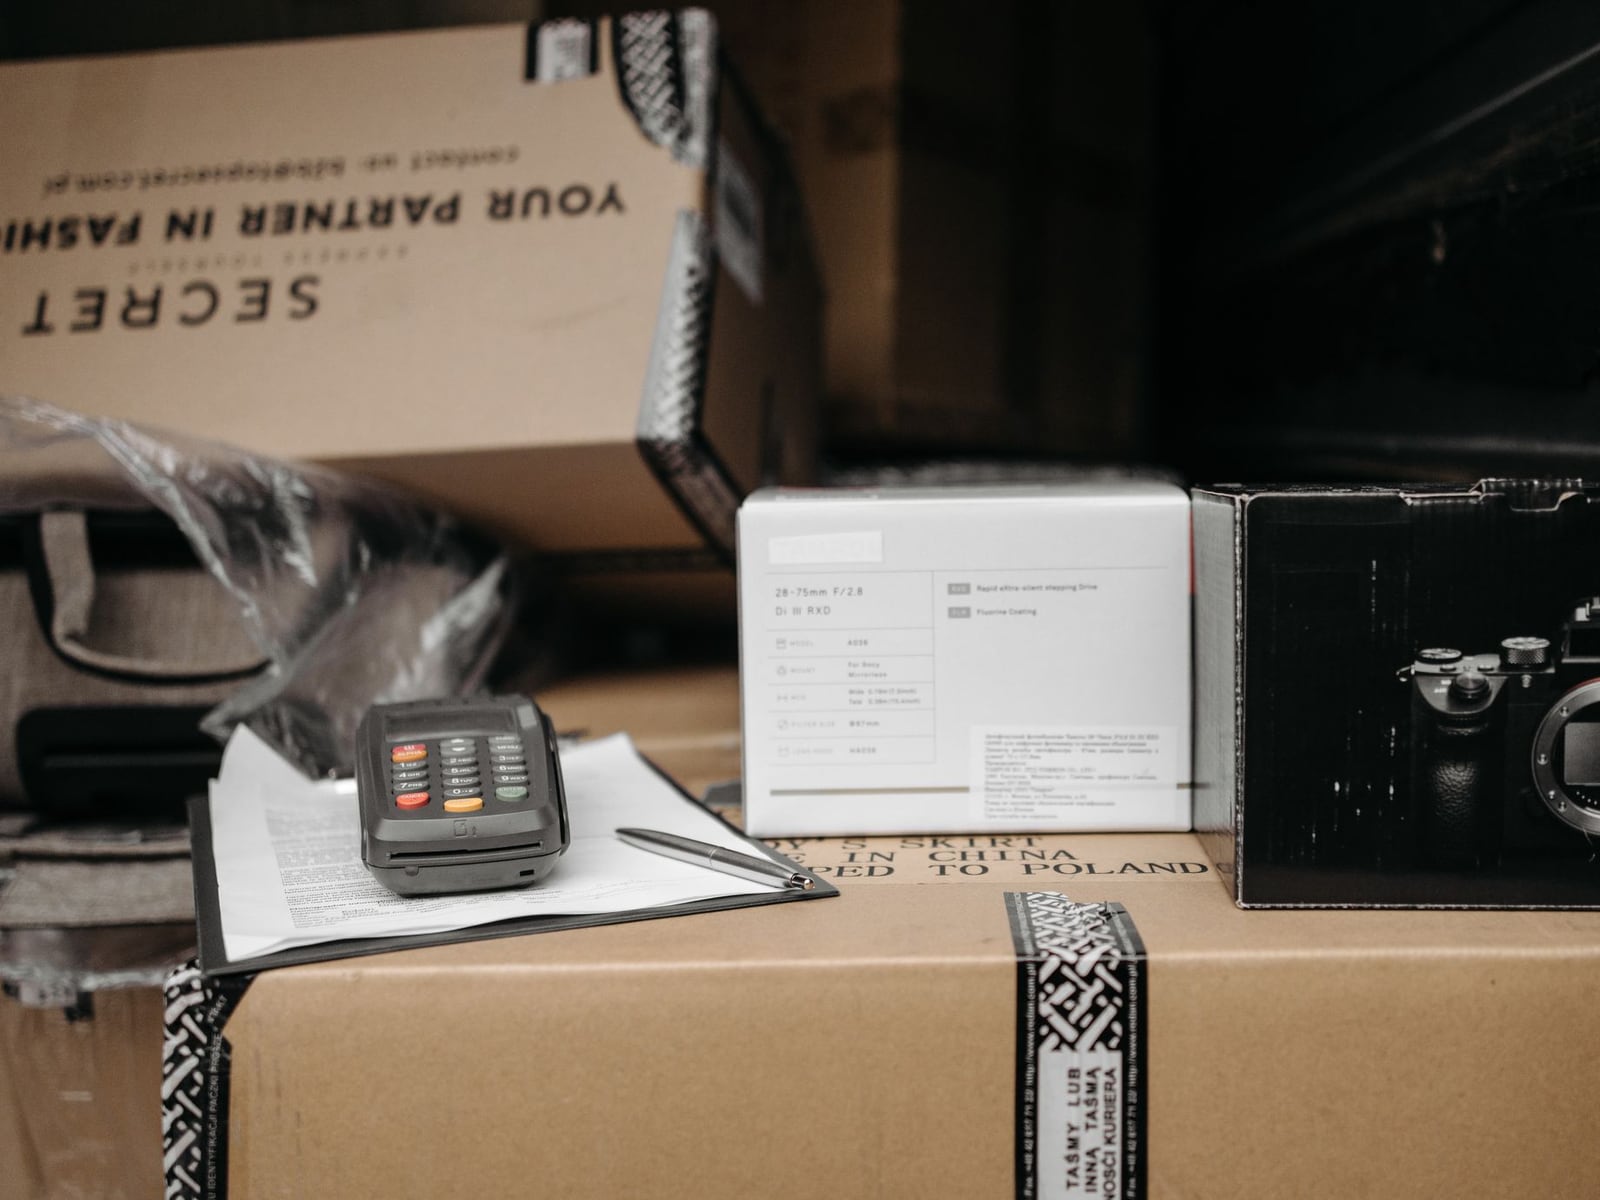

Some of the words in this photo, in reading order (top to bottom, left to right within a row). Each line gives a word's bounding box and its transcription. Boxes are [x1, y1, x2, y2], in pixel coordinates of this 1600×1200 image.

[410, 145, 520, 170] contact
[240, 193, 462, 238] PARTNER
[489, 182, 625, 219] YOUR
[0, 213, 141, 255] FASHI
[166, 210, 216, 243] IN
[20, 274, 321, 337] SECRET
[775, 587, 828, 598] 28-75mm
[833, 587, 864, 597] F/2.8
[977, 584, 997, 592] Rapid
[1045, 584, 1077, 592] stepping
[1079, 583, 1098, 591] Drive
[775, 606, 787, 616] Di
[807, 606, 831, 616] RXD
[977, 608, 1007, 616] Fluorine
[1008, 608, 1037, 617] Coating
[843, 851, 895, 862] IN
[928, 850, 1080, 862] CHINA
[900, 836, 1043, 849] SKIRT
[928, 863, 990, 877] TO
[1025, 861, 1209, 876] POLAND
[1068, 1068, 1081, 1106] LUB
[1085, 1067, 1102, 1131] TAŚMĄ
[1103, 1068, 1117, 1147] KURIERA
[1066, 1123, 1081, 1190] TAŚMY
[1085, 1146, 1101, 1193] INNĄ
